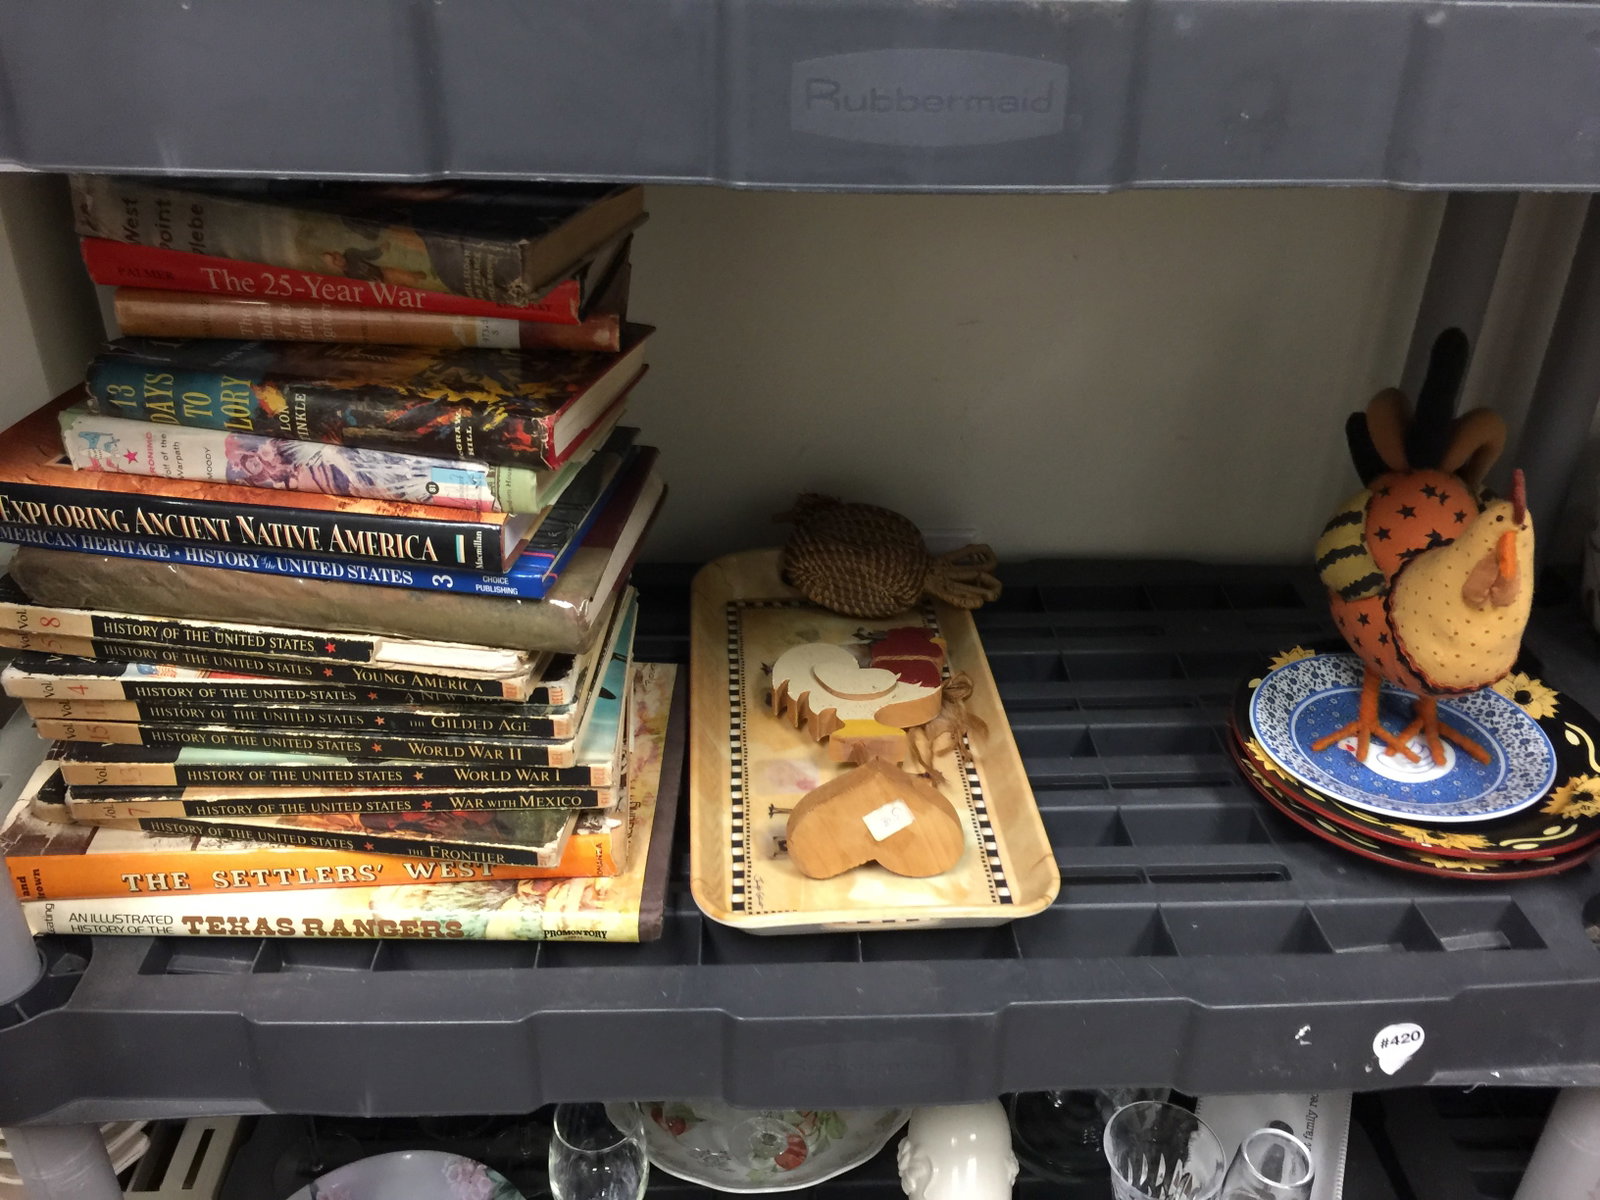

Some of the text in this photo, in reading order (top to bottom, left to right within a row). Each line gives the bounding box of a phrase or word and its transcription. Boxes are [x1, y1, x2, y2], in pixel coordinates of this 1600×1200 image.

[805, 77, 1051, 113] Rubbermaid
[200, 268, 427, 308] The 25-Year War
[107, 384, 137, 408] 13
[144, 373, 180, 425] DAYS
[182, 391, 213, 418] TO
[221, 375, 255, 431] LORY
[160, 433, 168, 448] the
[466, 425, 475, 456] HILL
[146, 432, 156, 475] RONIMO
[204, 447, 214, 479] MOODY
[0, 494, 439, 562] EXPLORING ANCIENT NATIVE AMERICA
[0, 526, 78, 548] MERICAN
[82, 534, 170, 559] HERITAGE
[185, 548, 260, 569] HISTORY
[276, 556, 343, 578] UNITED
[348, 564, 413, 585] STATES
[432, 574, 453, 588] 3
[475, 584, 518, 596] PUBLISHING
[482, 575, 509, 585] CHOICE
[40, 617, 60, 628] 8
[104, 622, 315, 652] HISTORY OF THE UNITED STATES
[104, 645, 158, 660] HISTORY
[162, 651, 179, 662] OF
[184, 653, 208, 665] THE
[213, 656, 264, 671] UNITED
[268, 661, 313, 676] STATES
[352, 668, 405, 685] YOUNG
[411, 674, 484, 693] AMERICA
[67, 684, 89, 696] 4
[136, 687, 194, 698] HISTORY
[199, 688, 216, 698] OF
[222, 688, 249, 699] THE
[253, 689, 306, 700] UNITED
[309, 690, 357, 701] STATES
[150, 707, 206, 719] HISTORY
[210, 709, 228, 719] OF
[232, 710, 258, 721] THE
[263, 711, 314, 723] UNITED
[319, 713, 364, 725] STATES
[431, 716, 493, 731] GILDED
[499, 719, 531, 732] AGE
[152, 731, 522, 761] HISTORY OF THE UNITED STATES WORLD WAR II
[187, 770, 244, 782] HISTORY
[249, 770, 266, 781] OF
[271, 770, 297, 781] THE
[302, 770, 353, 782] UNITED
[357, 770, 403, 782] STATES
[454, 768, 511, 782] WORLD
[515, 768, 550, 782] WAR
[128, 808, 150, 817] 7
[196, 795, 582, 816] HISTORY OF THE UNITED STATES WAR WITH MEXICO
[151, 821, 206, 835] HISTORY
[208, 826, 224, 836] OF
[228, 829, 253, 839] THE
[258, 831, 307, 845] UNITED
[311, 837, 353, 850] STATES
[429, 845, 505, 864] FRONTIER
[121, 861, 496, 893] THE SETTLERS' WEST
[44, 903, 56, 936] eating
[69, 912, 174, 925] AN ILLUSTRATED
[71, 925, 174, 935] HISTORY OF THE
[181, 915, 465, 938] TEXAS RANGERS
[543, 929, 608, 939] PROMONTORY
[1380, 1030, 1421, 1049] #420
[1310, 1093, 1320, 1107] rec
[1303, 1108, 1318, 1141] family
